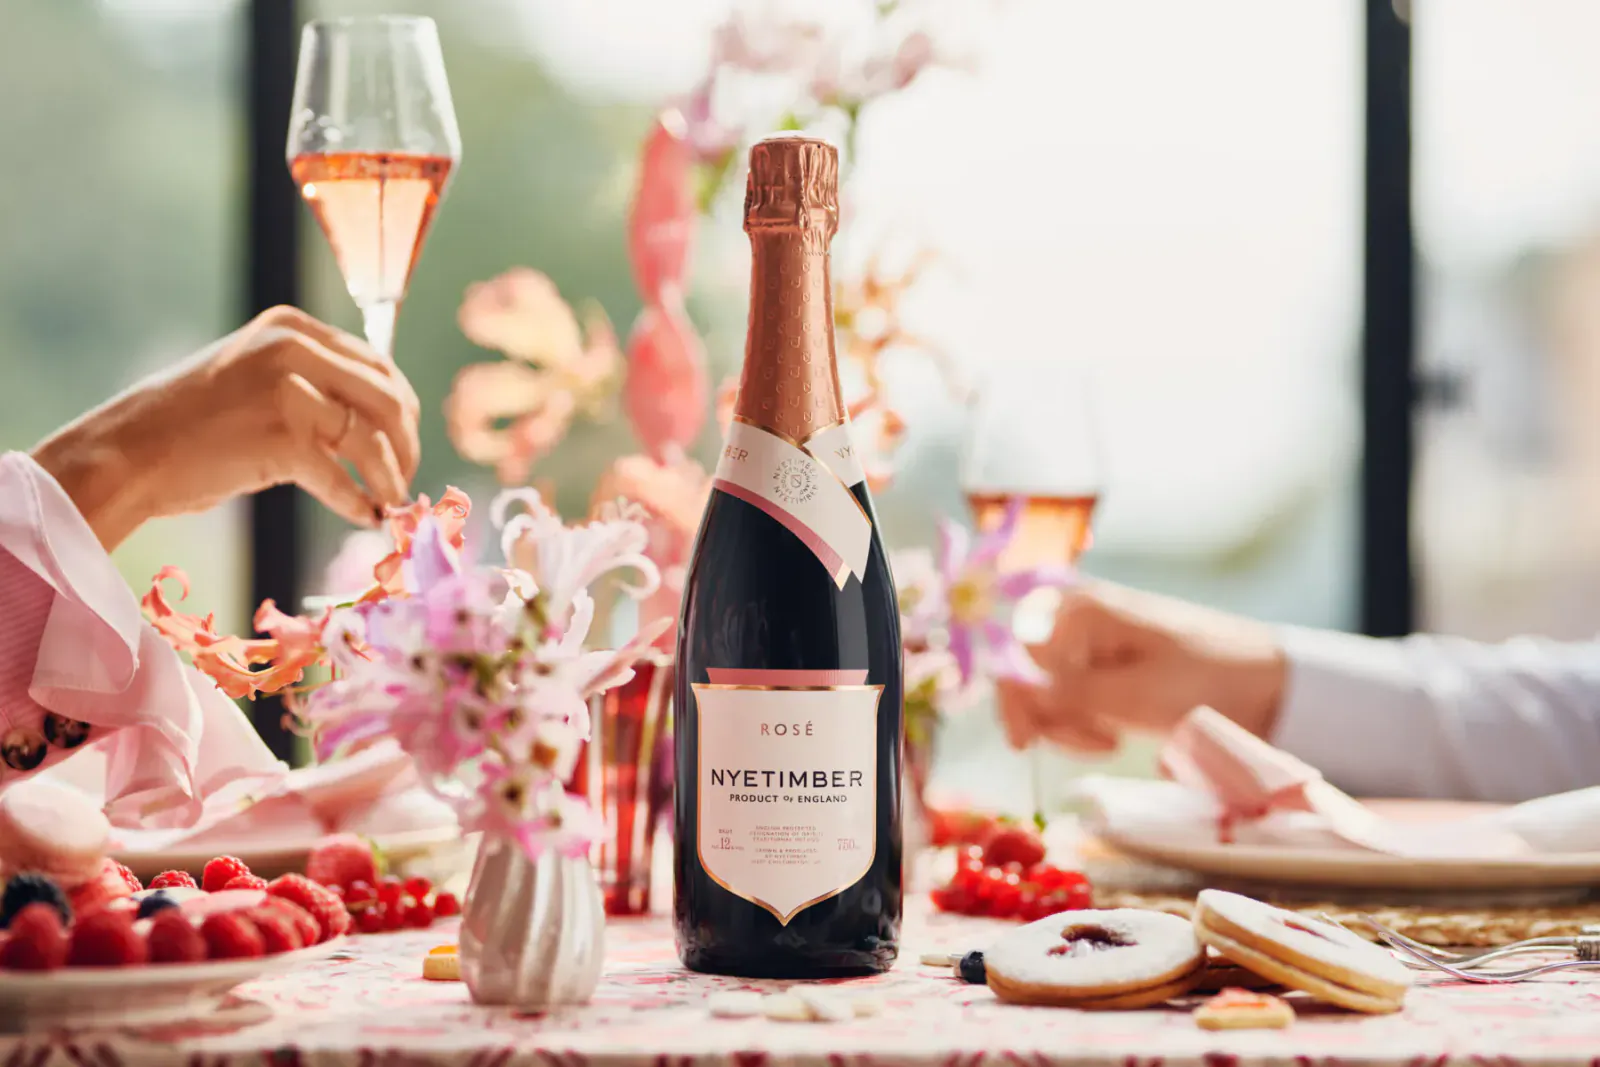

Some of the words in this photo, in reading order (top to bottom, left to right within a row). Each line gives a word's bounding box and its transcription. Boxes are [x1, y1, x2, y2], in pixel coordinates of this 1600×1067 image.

[760, 720, 814, 736] ROSÉ
[711, 768, 863, 788] NYETIMBER
[729, 793, 779, 803] PRODUCT
[797, 794, 847, 803] ENGLAND
[720, 837, 731, 850] 12
[837, 838, 855, 851] 750
